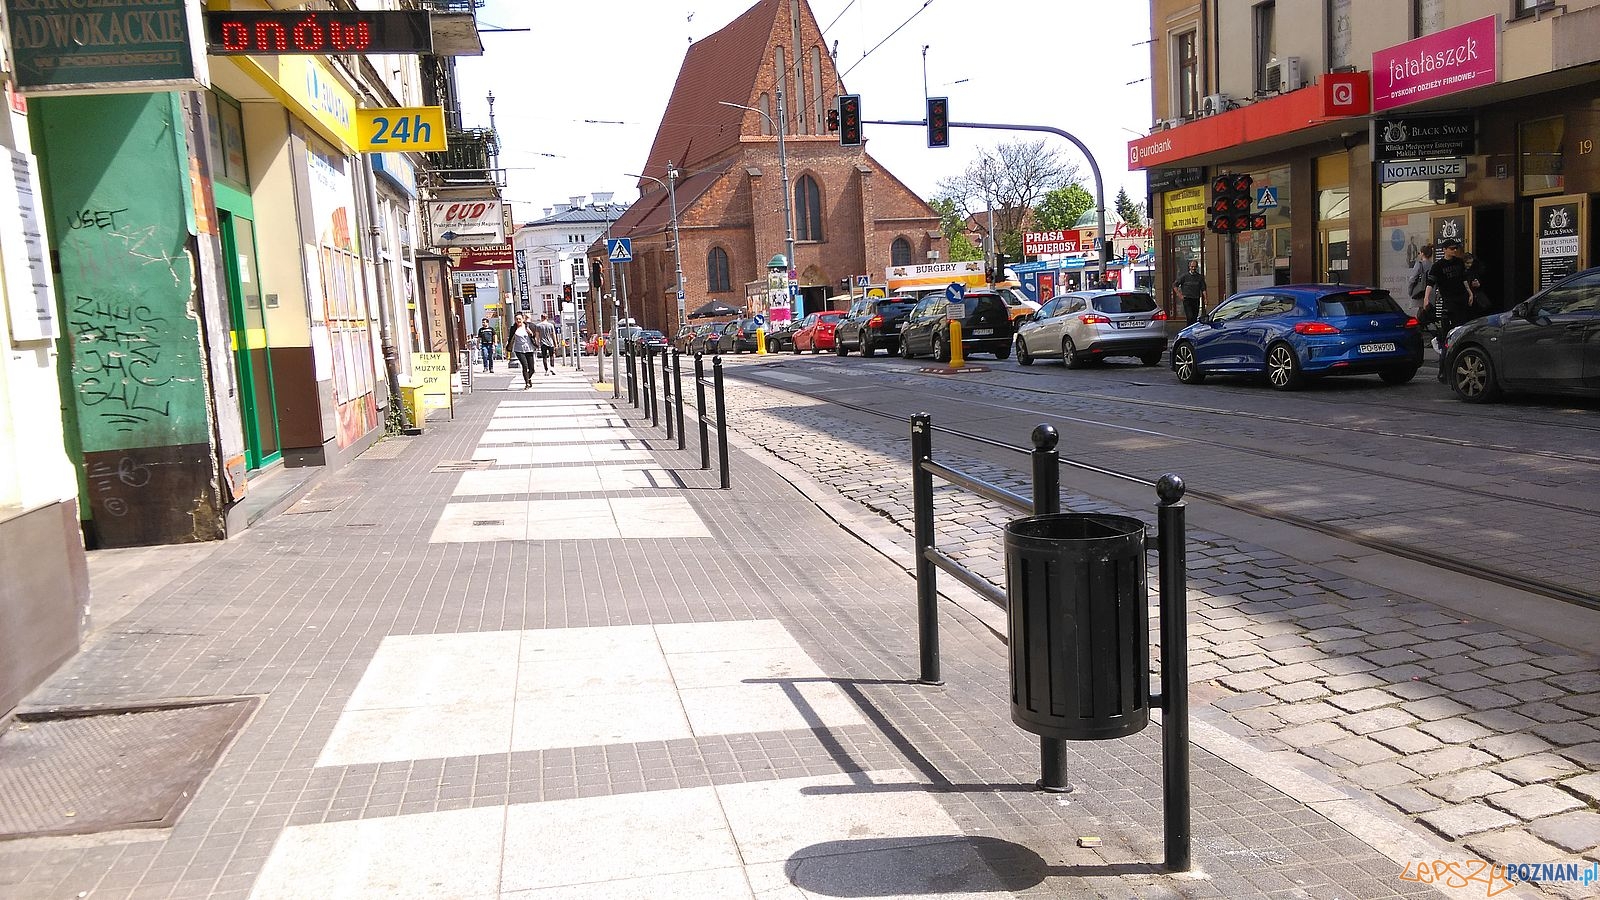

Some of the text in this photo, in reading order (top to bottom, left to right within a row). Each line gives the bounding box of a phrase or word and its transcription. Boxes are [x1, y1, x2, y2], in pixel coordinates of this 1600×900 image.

[14, 9, 185, 49] ADWOKACKIE
[1390, 71, 1476, 99] DYSKONT ODZIEŻY FIRMOWEJ
[370, 114, 431, 144] 24h
[1412, 125, 1469, 137] BLACK SWAN
[1139, 138, 1172, 158] eurobank
[1578, 139, 1593, 155] 19
[1387, 163, 1460, 178] NOTARIUSZE
[1025, 231, 1064, 243] PRASA
[1026, 241, 1076, 254] PAPIEROSY
[1541, 244, 1577, 255] HAIR STUDIO
[916, 263, 957, 274] BURGERY
[419, 353, 441, 361] FILMY
